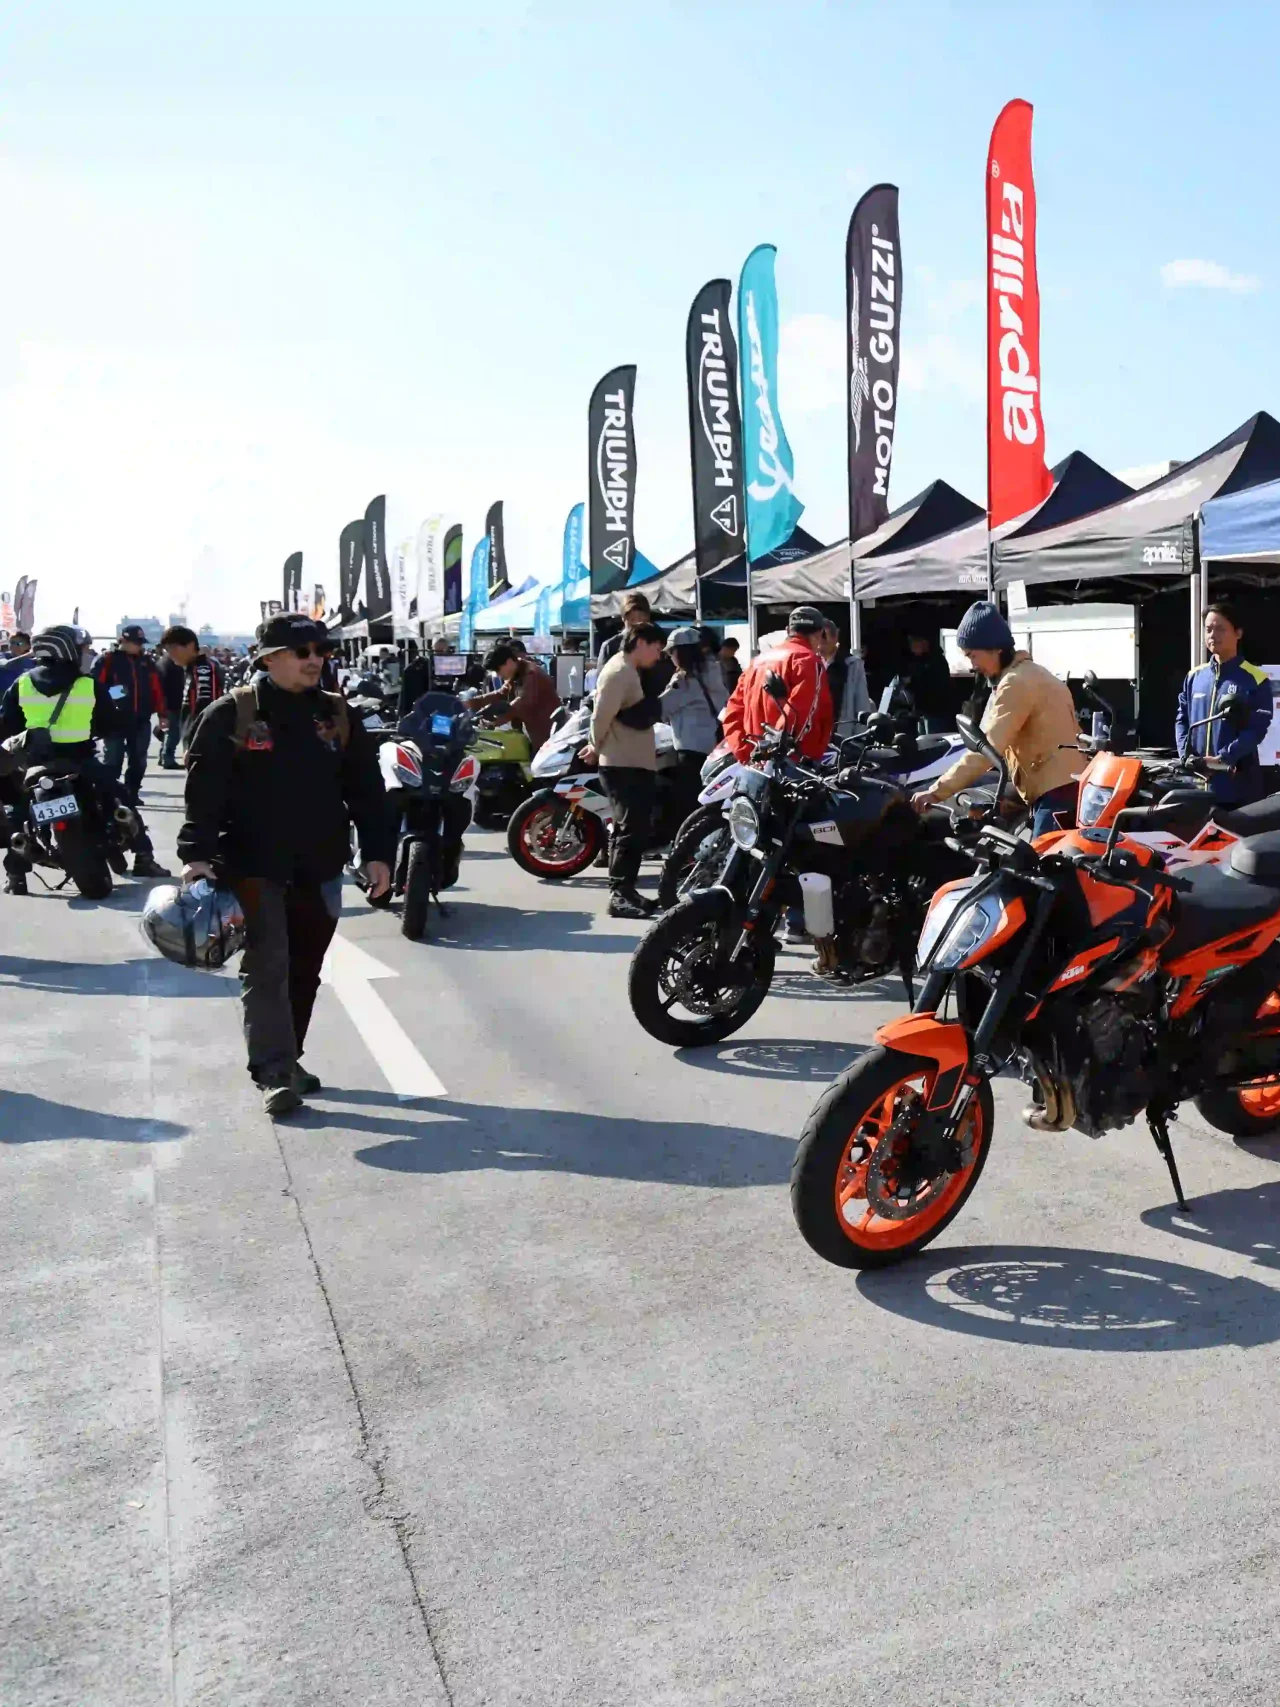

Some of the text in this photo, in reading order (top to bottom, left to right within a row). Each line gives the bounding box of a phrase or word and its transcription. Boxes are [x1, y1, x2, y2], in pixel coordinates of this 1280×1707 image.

[870, 240, 895, 496] MOTO GUZZI
[992, 182, 1038, 445] aprilia
[601, 388, 628, 532] TRIUMPH
[700, 308, 734, 487] TRIUMPH
[38, 802, 77, 820] 43-09
[1061, 965, 1085, 982] KTM
